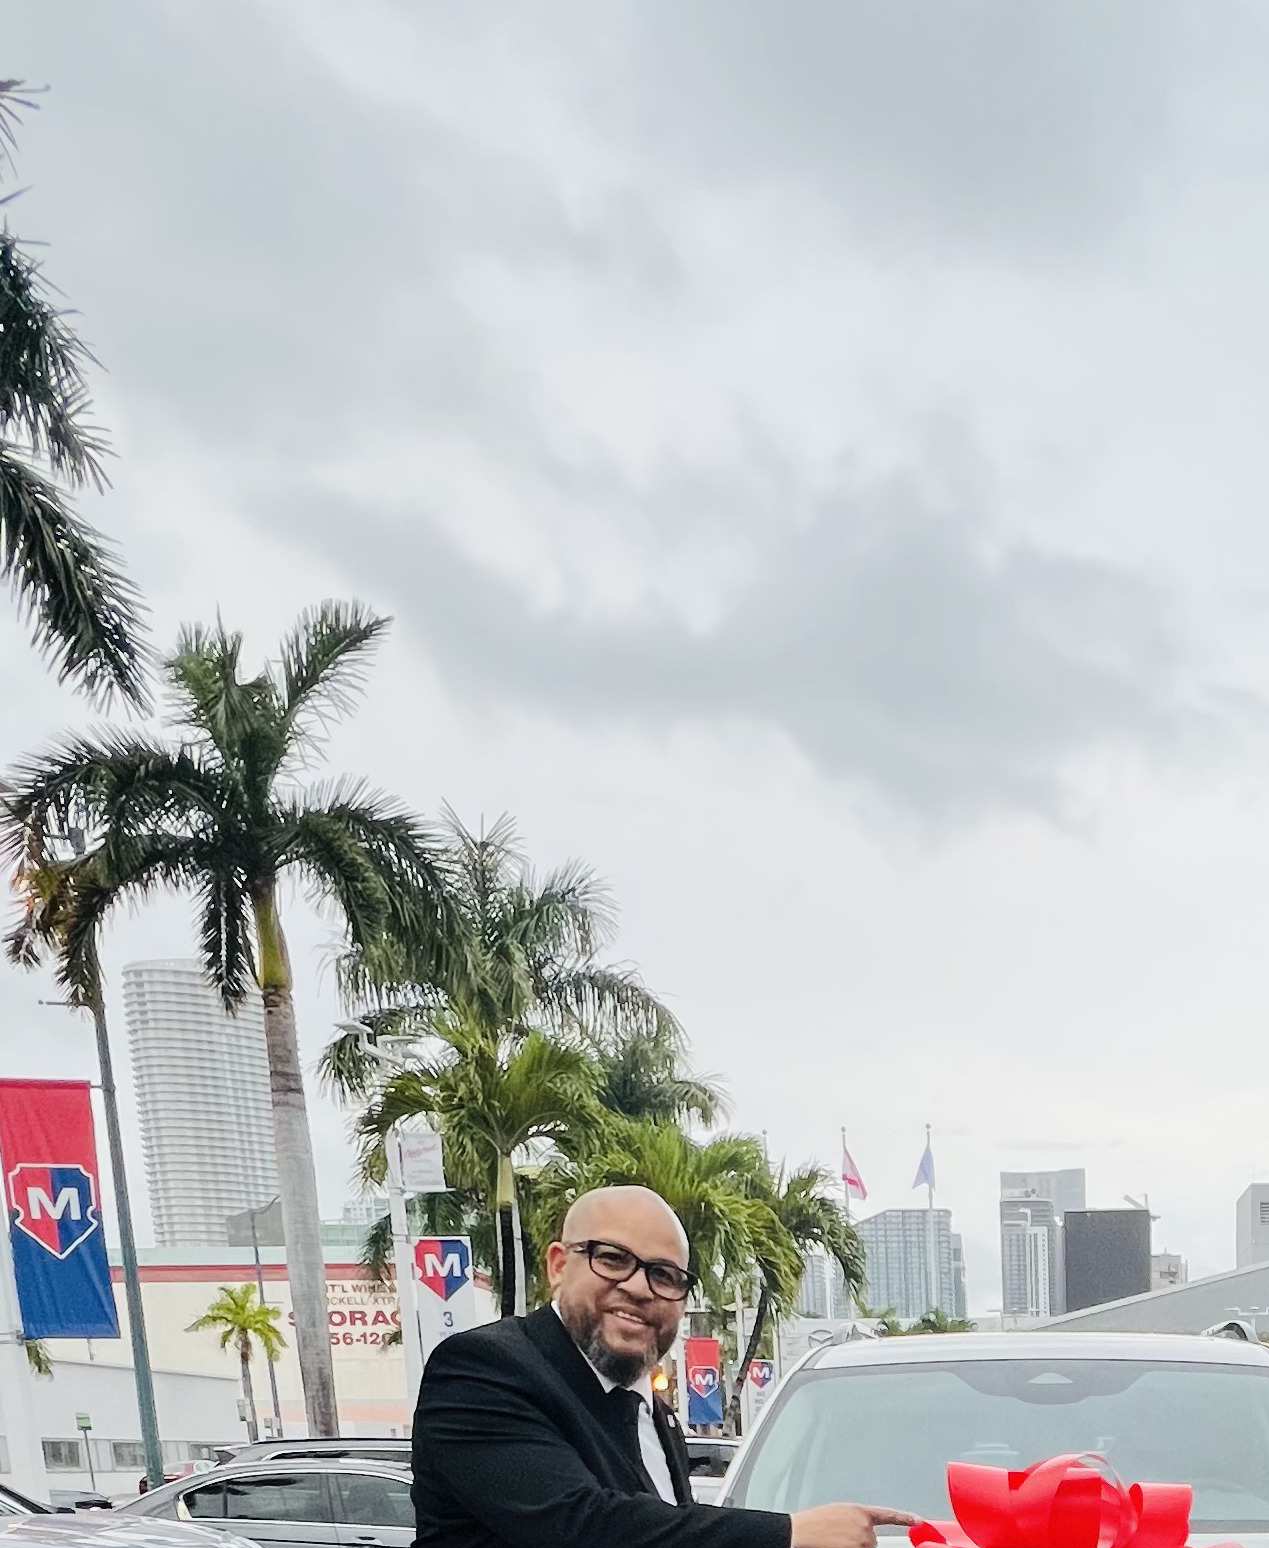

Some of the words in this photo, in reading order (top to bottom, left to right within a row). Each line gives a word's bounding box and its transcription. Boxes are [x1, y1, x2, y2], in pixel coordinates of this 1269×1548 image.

[27, 1187, 82, 1220] M
[424, 1253, 462, 1278] M
[443, 1311, 454, 1327] 3
